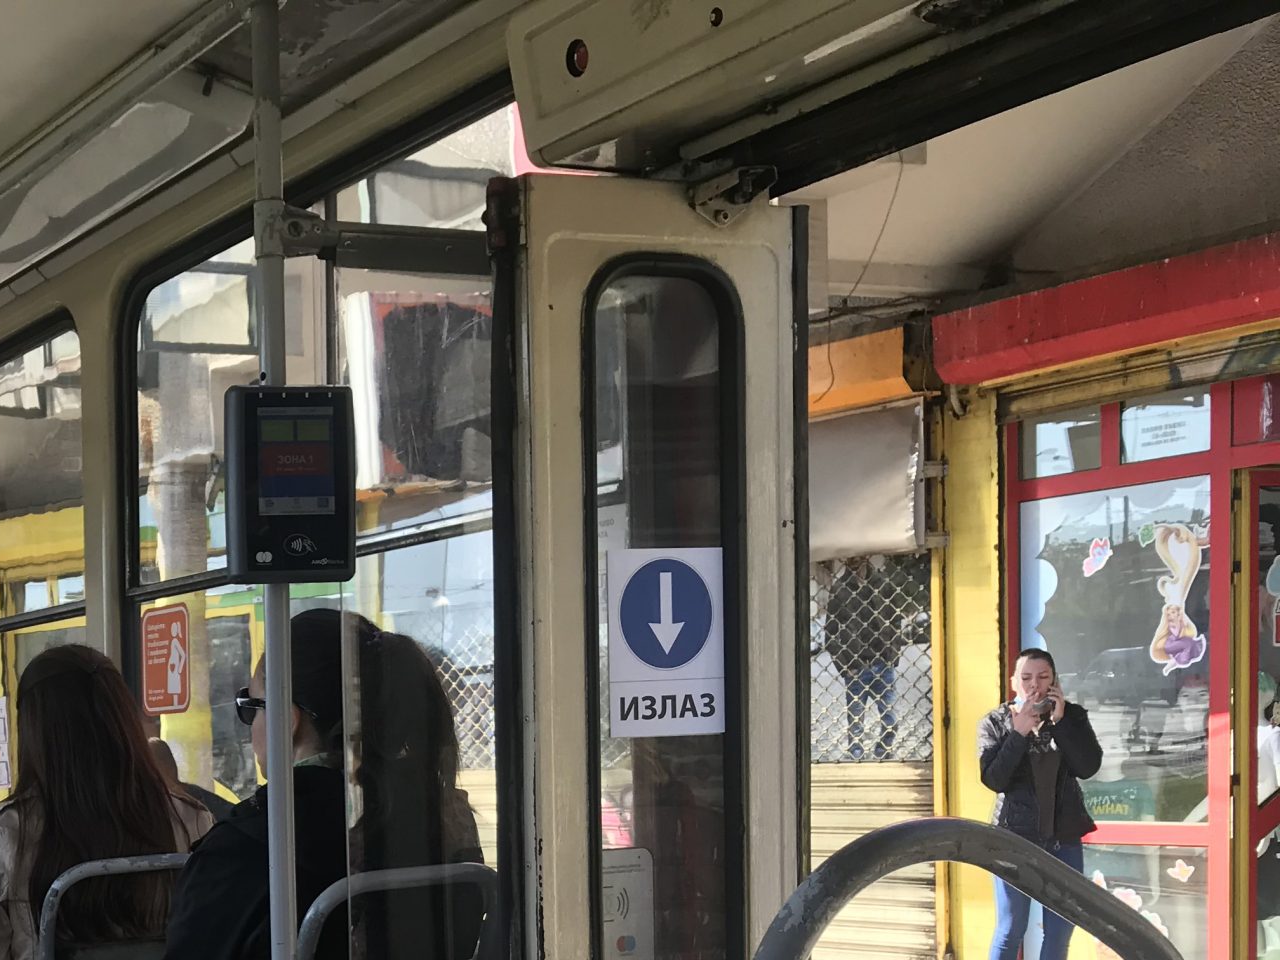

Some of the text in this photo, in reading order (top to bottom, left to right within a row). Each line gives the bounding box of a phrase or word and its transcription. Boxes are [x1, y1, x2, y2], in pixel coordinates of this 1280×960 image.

[277, 455, 313, 464] ЗОНА 1
[619, 693, 716, 721] ИЗЛАЗ
